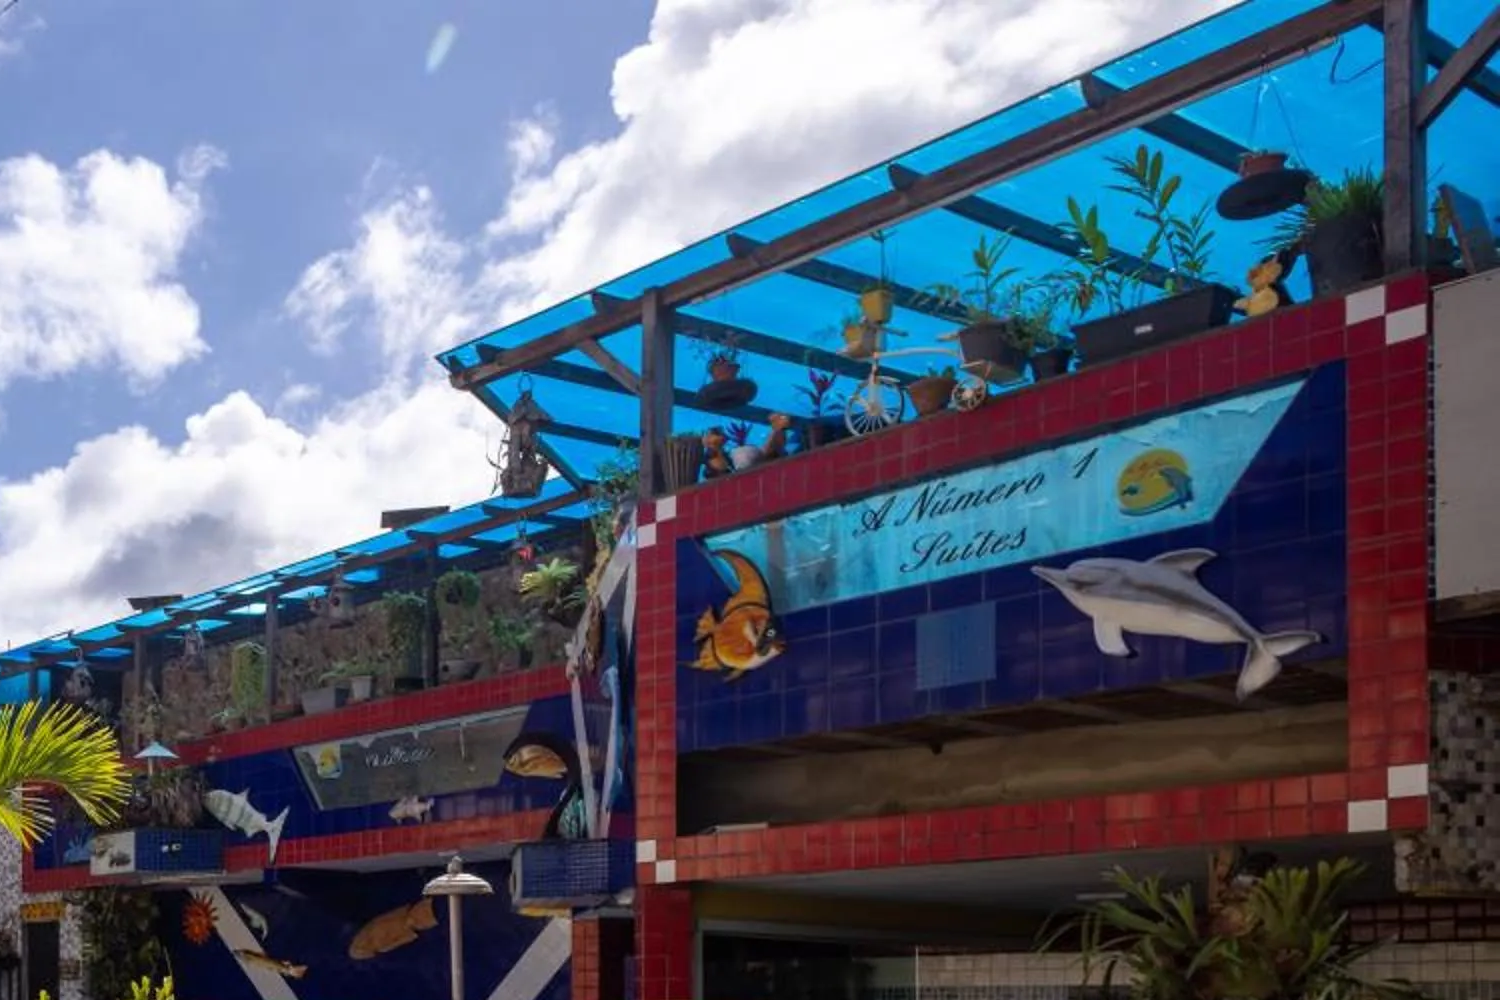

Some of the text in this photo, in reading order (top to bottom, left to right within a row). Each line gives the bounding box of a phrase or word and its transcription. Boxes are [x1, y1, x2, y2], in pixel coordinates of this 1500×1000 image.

[852, 447, 1099, 537] A Número 1
